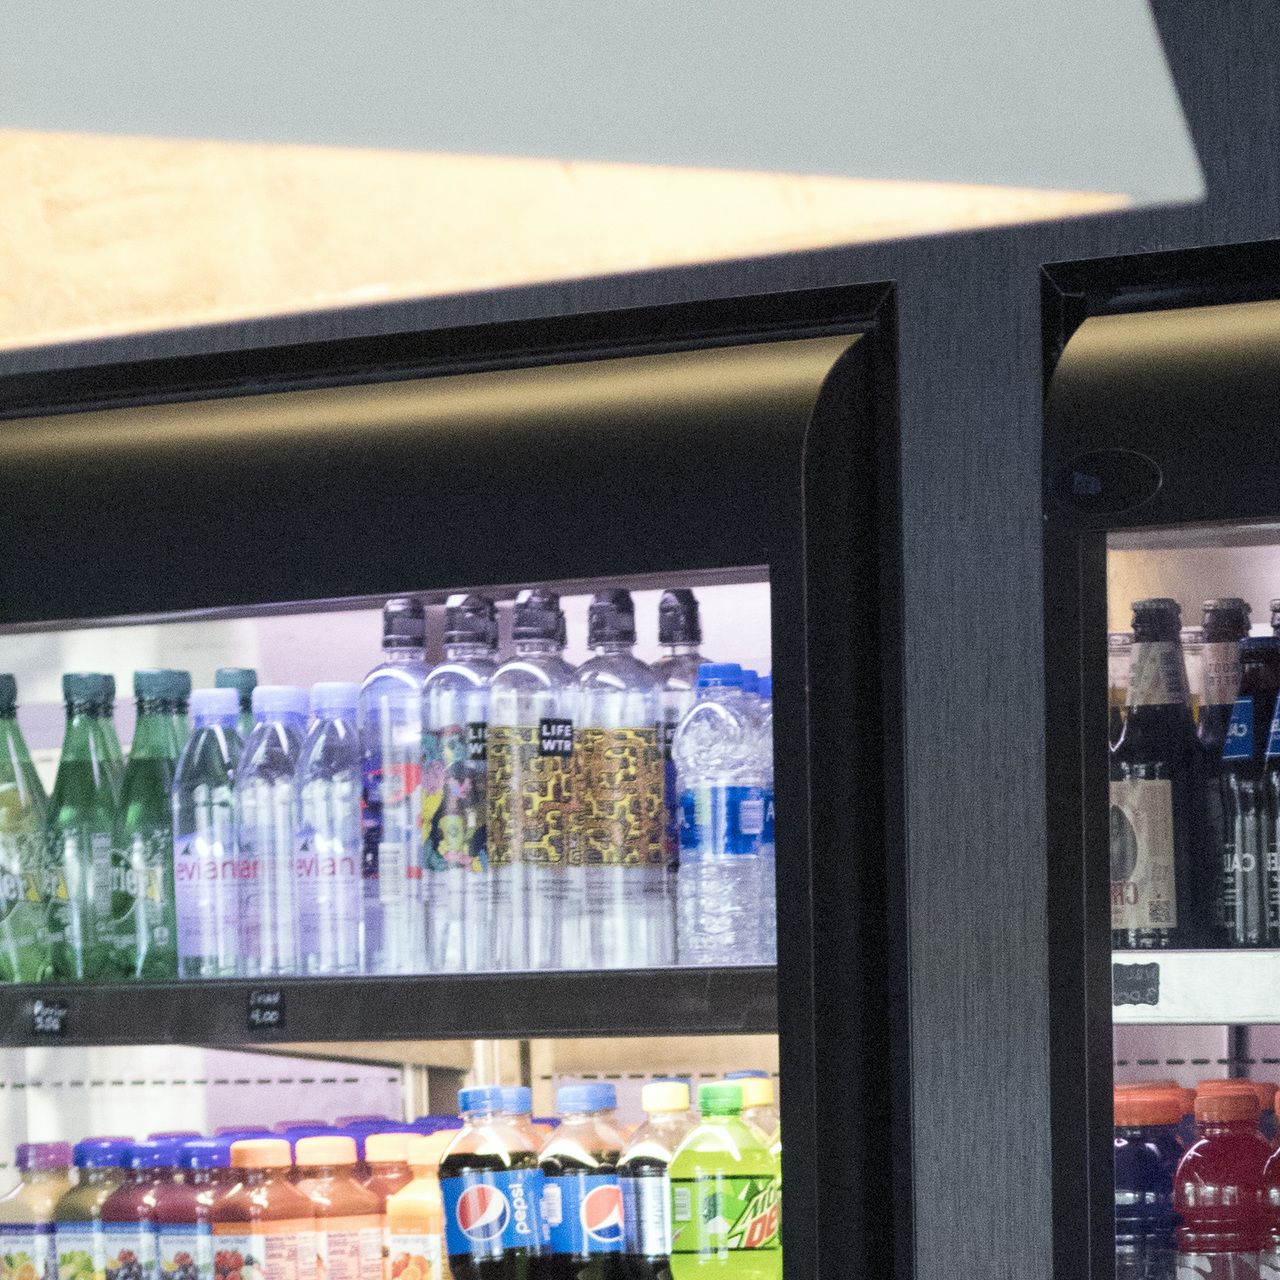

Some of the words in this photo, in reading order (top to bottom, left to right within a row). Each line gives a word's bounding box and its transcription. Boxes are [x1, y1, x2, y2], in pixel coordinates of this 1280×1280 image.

[541, 724, 572, 738] LIFE
[542, 739, 572, 752] WTR
[296, 854, 355, 879] evian
[509, 1182, 532, 1235] pepsi
